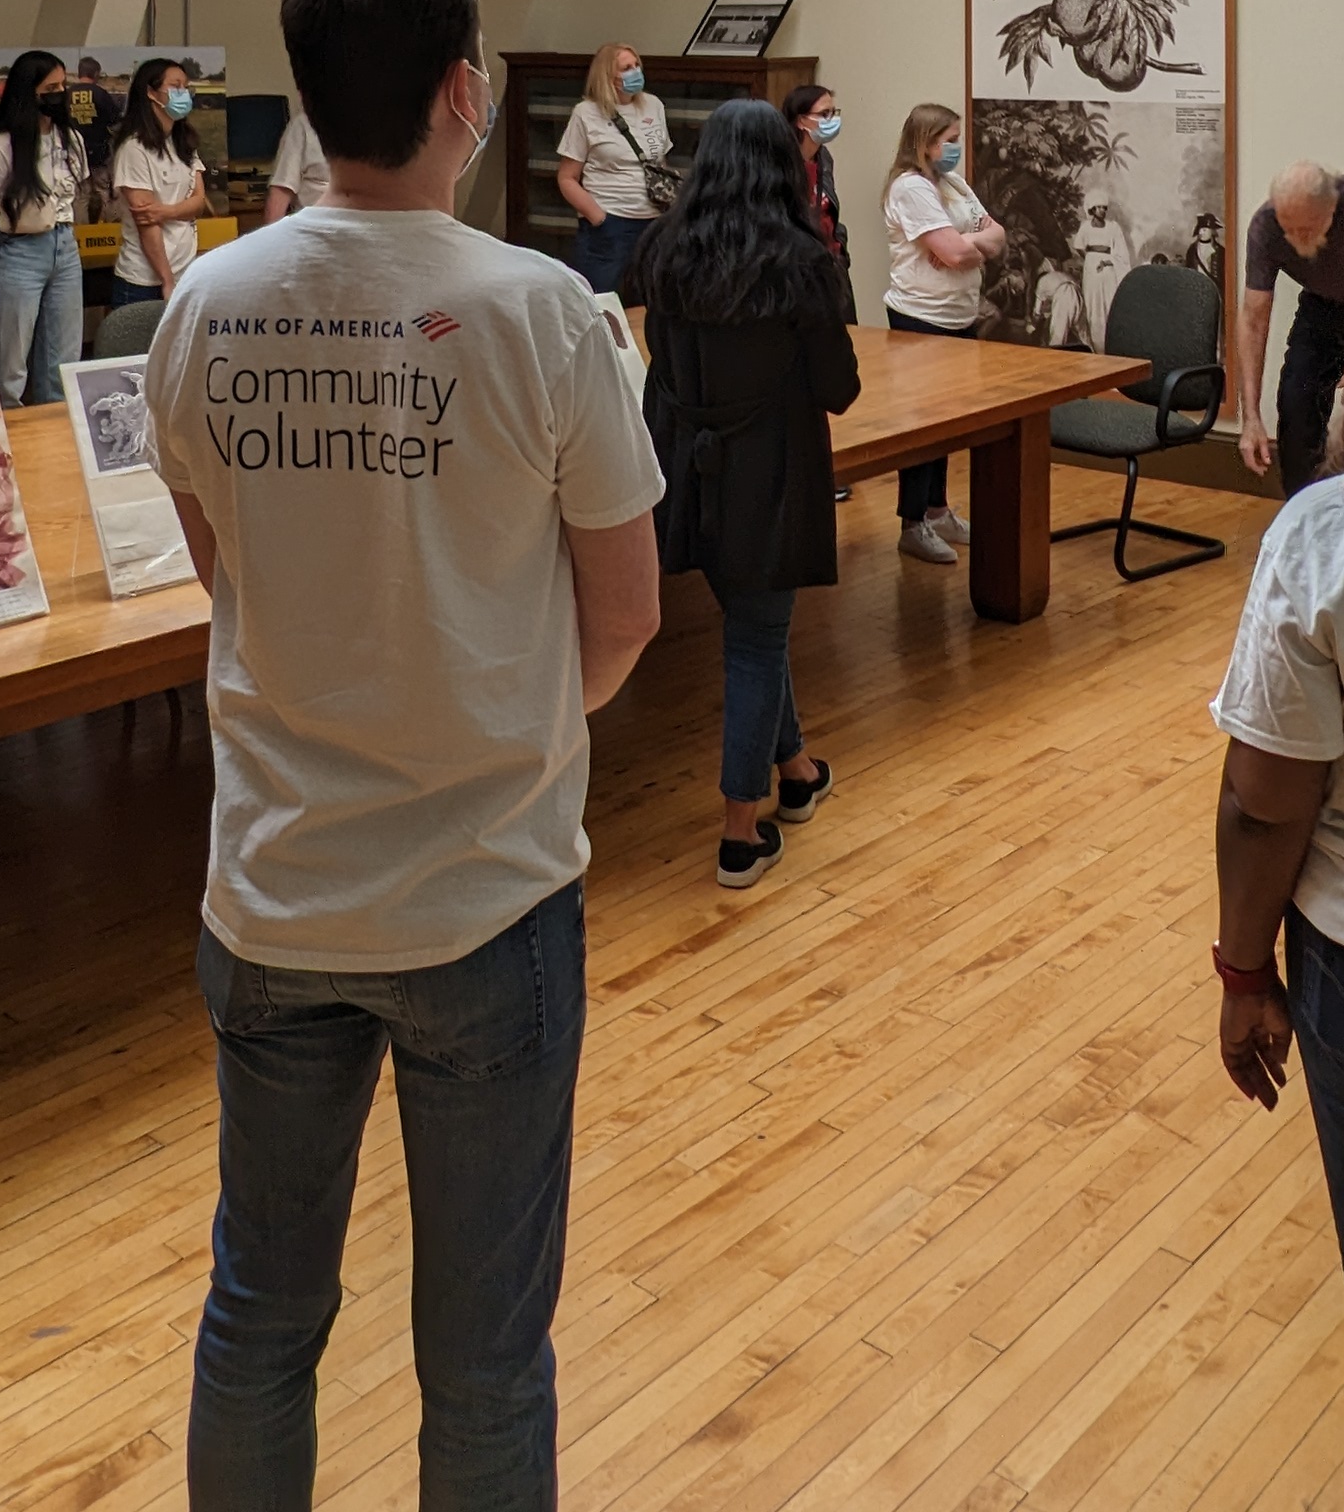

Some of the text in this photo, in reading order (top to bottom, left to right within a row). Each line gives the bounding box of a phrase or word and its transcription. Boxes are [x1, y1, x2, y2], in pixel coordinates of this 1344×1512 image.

[71, 90, 93, 104] FBI
[208, 318, 406, 339] BANK OF AMERICA
[206, 356, 458, 426] Community
[206, 410, 454, 479] Volunteer
